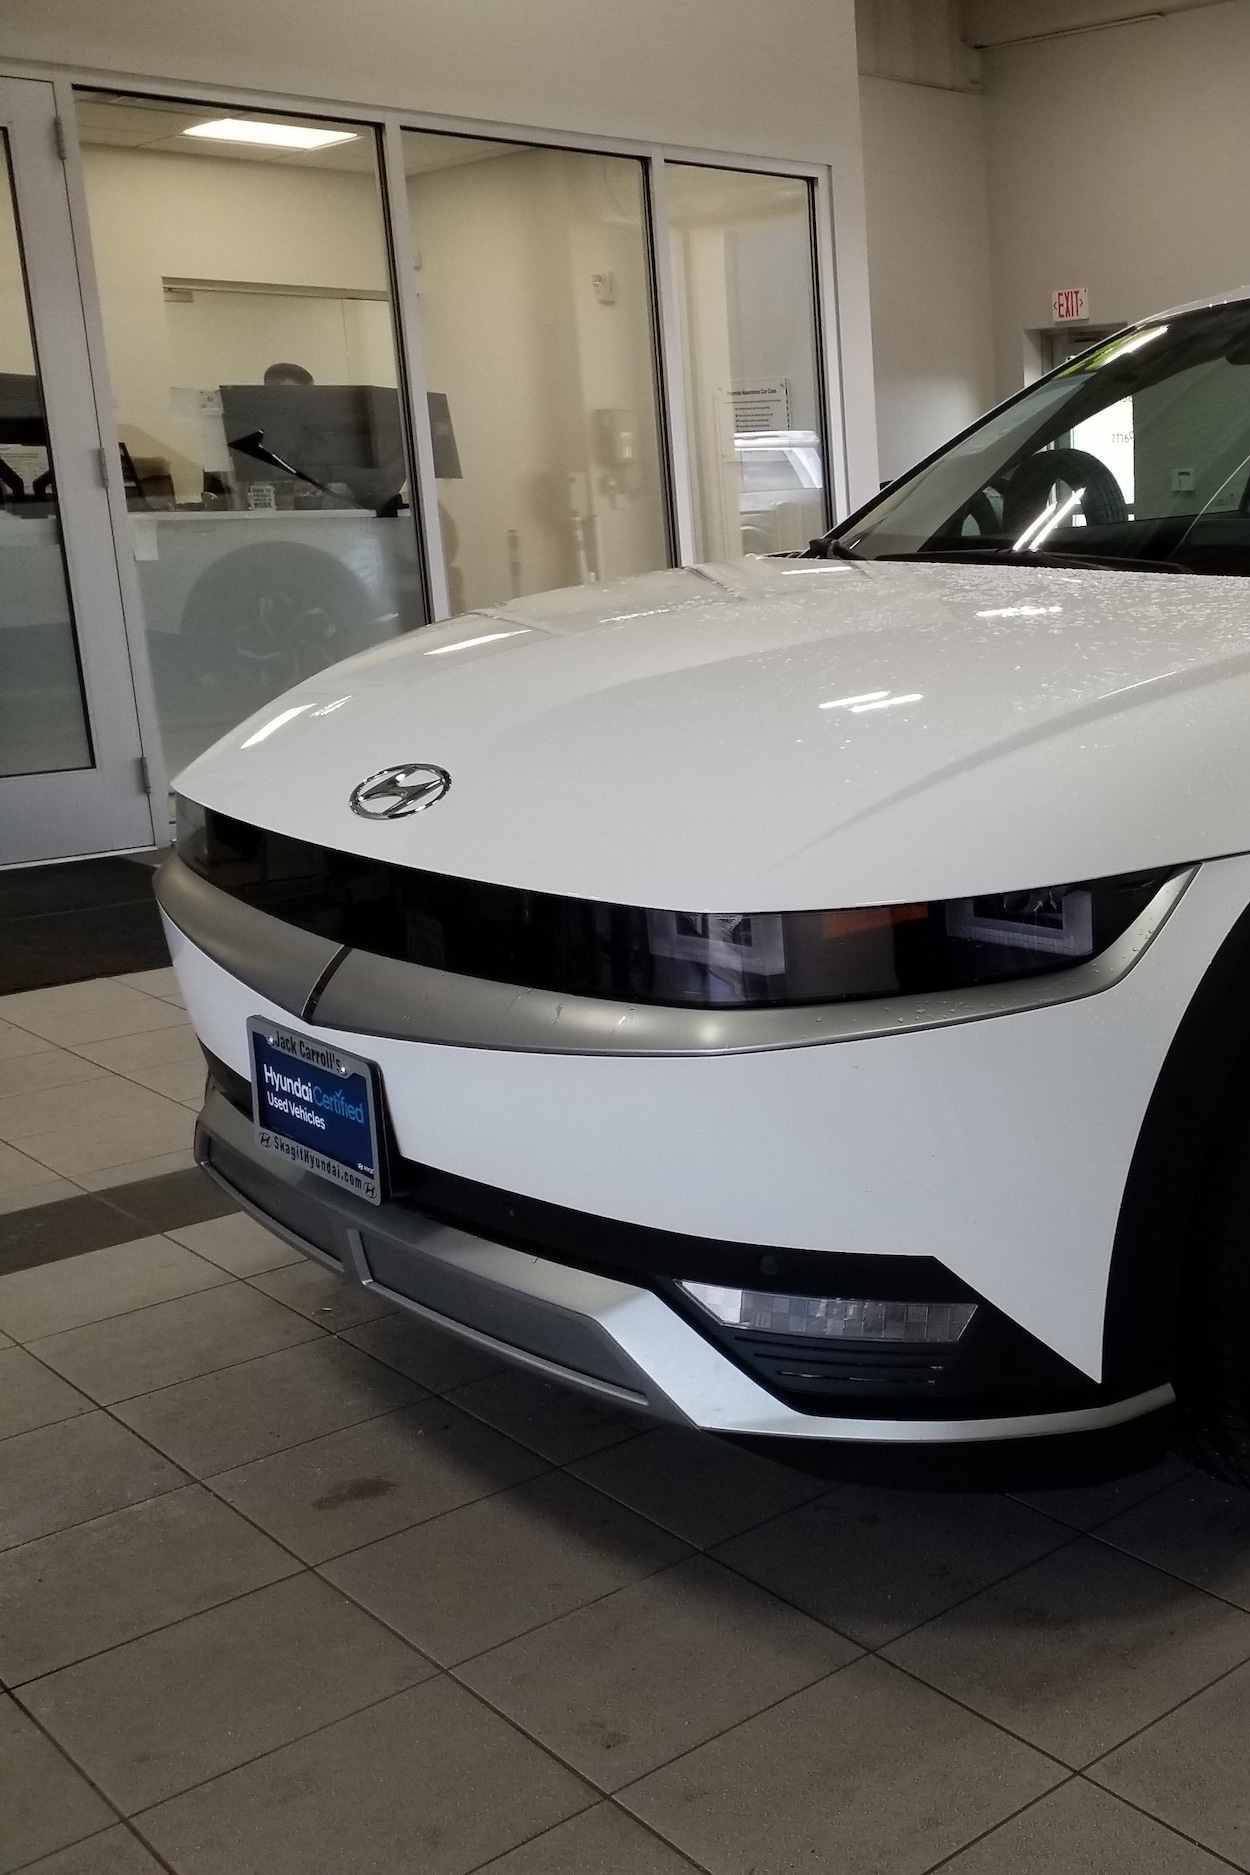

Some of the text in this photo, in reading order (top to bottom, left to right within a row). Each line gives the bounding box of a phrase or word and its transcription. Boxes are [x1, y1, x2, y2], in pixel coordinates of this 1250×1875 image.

[1057, 291, 1080, 318] EXIT
[273, 1031, 342, 1074] Jack Carroll's
[263, 1063, 365, 1125] Hyundai Certified
[267, 1091, 326, 1130] Used Vehicles
[273, 1135, 363, 1190] SkagitHyundai.com
